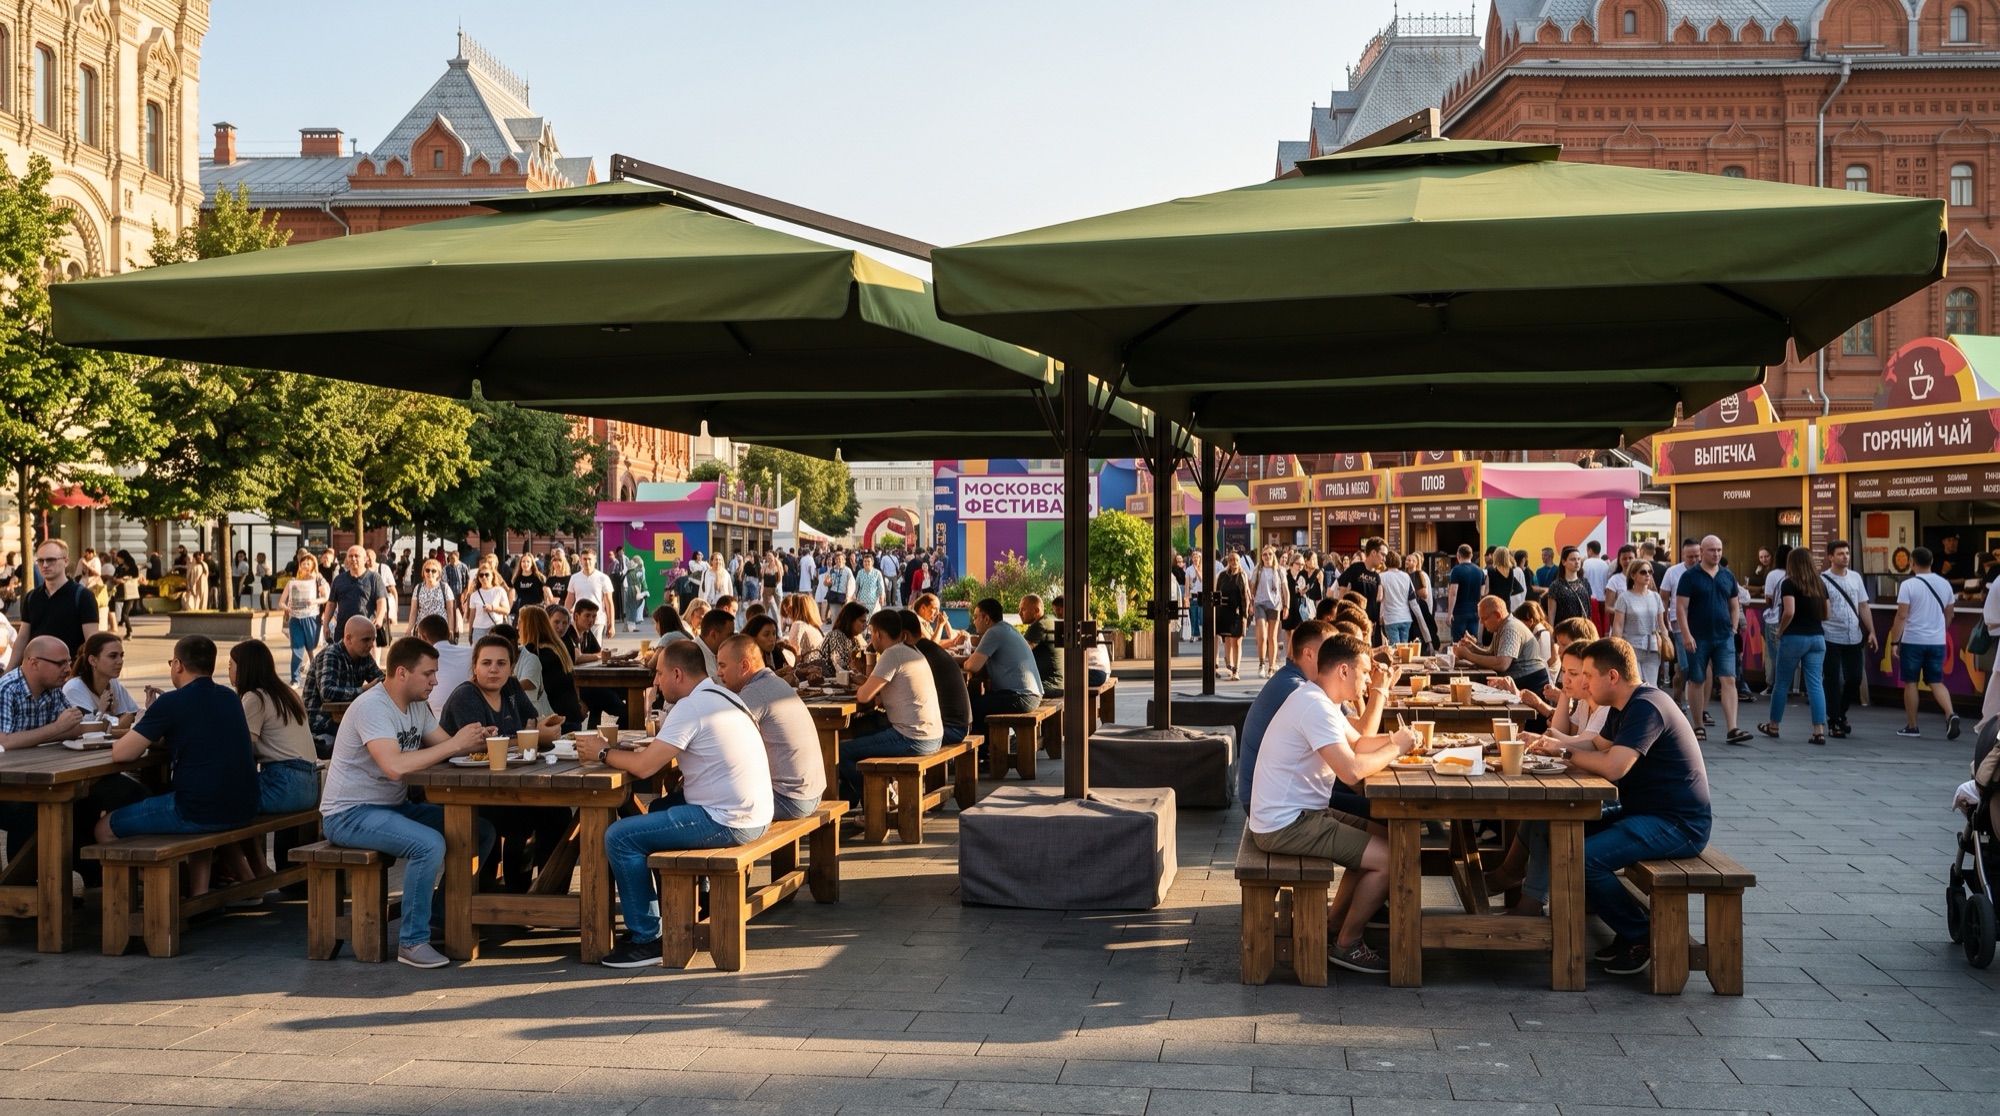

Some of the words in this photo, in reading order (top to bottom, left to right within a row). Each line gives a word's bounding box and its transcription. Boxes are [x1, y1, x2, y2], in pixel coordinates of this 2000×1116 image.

[1863, 421, 1934, 452] ГОРЯЧИЙ
[1938, 417, 1972, 446] ЧАЙ
[1694, 443, 1756, 466] ВЫПЕЧКА
[964, 483, 1091, 496] МОСКОВСК
[1325, 482, 1345, 496] ГРИЛЬ
[1421, 474, 1446, 491] ПЛОВ
[964, 498, 1092, 514] ФЕСТИВА
